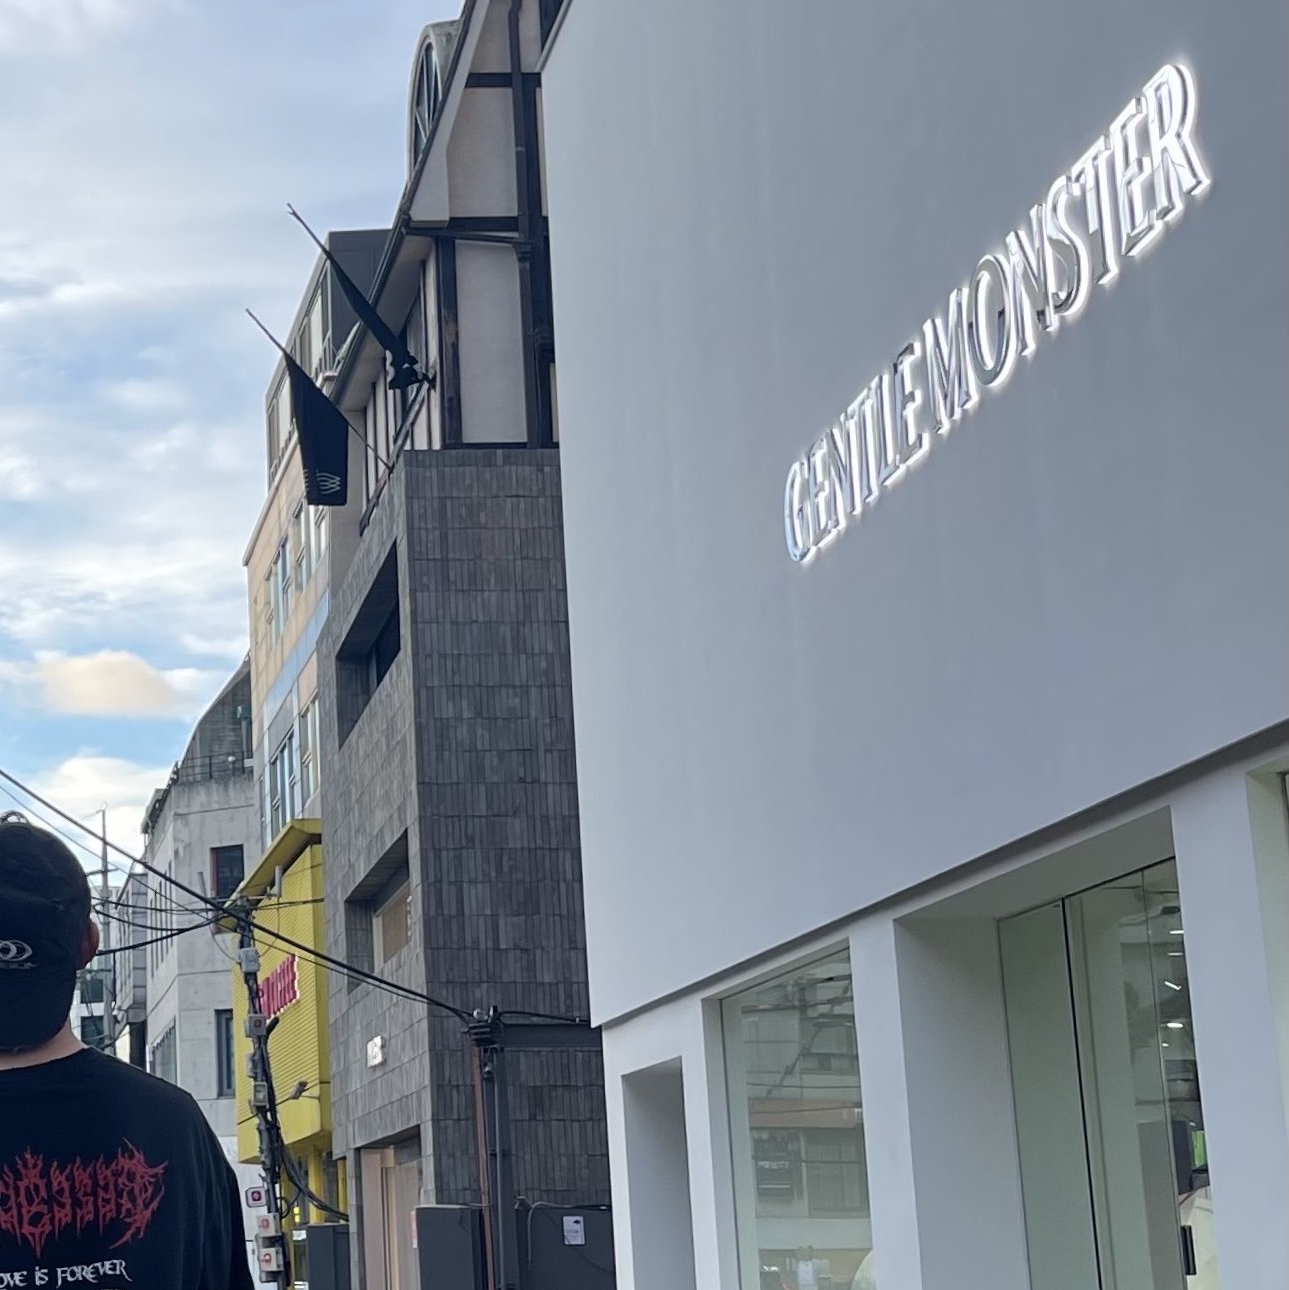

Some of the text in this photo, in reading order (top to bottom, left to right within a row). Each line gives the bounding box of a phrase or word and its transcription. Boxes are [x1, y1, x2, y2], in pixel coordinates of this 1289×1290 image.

[782, 62, 1213, 563] GENTLE MONSTER
[55, 1259, 133, 1290] FOREVER
